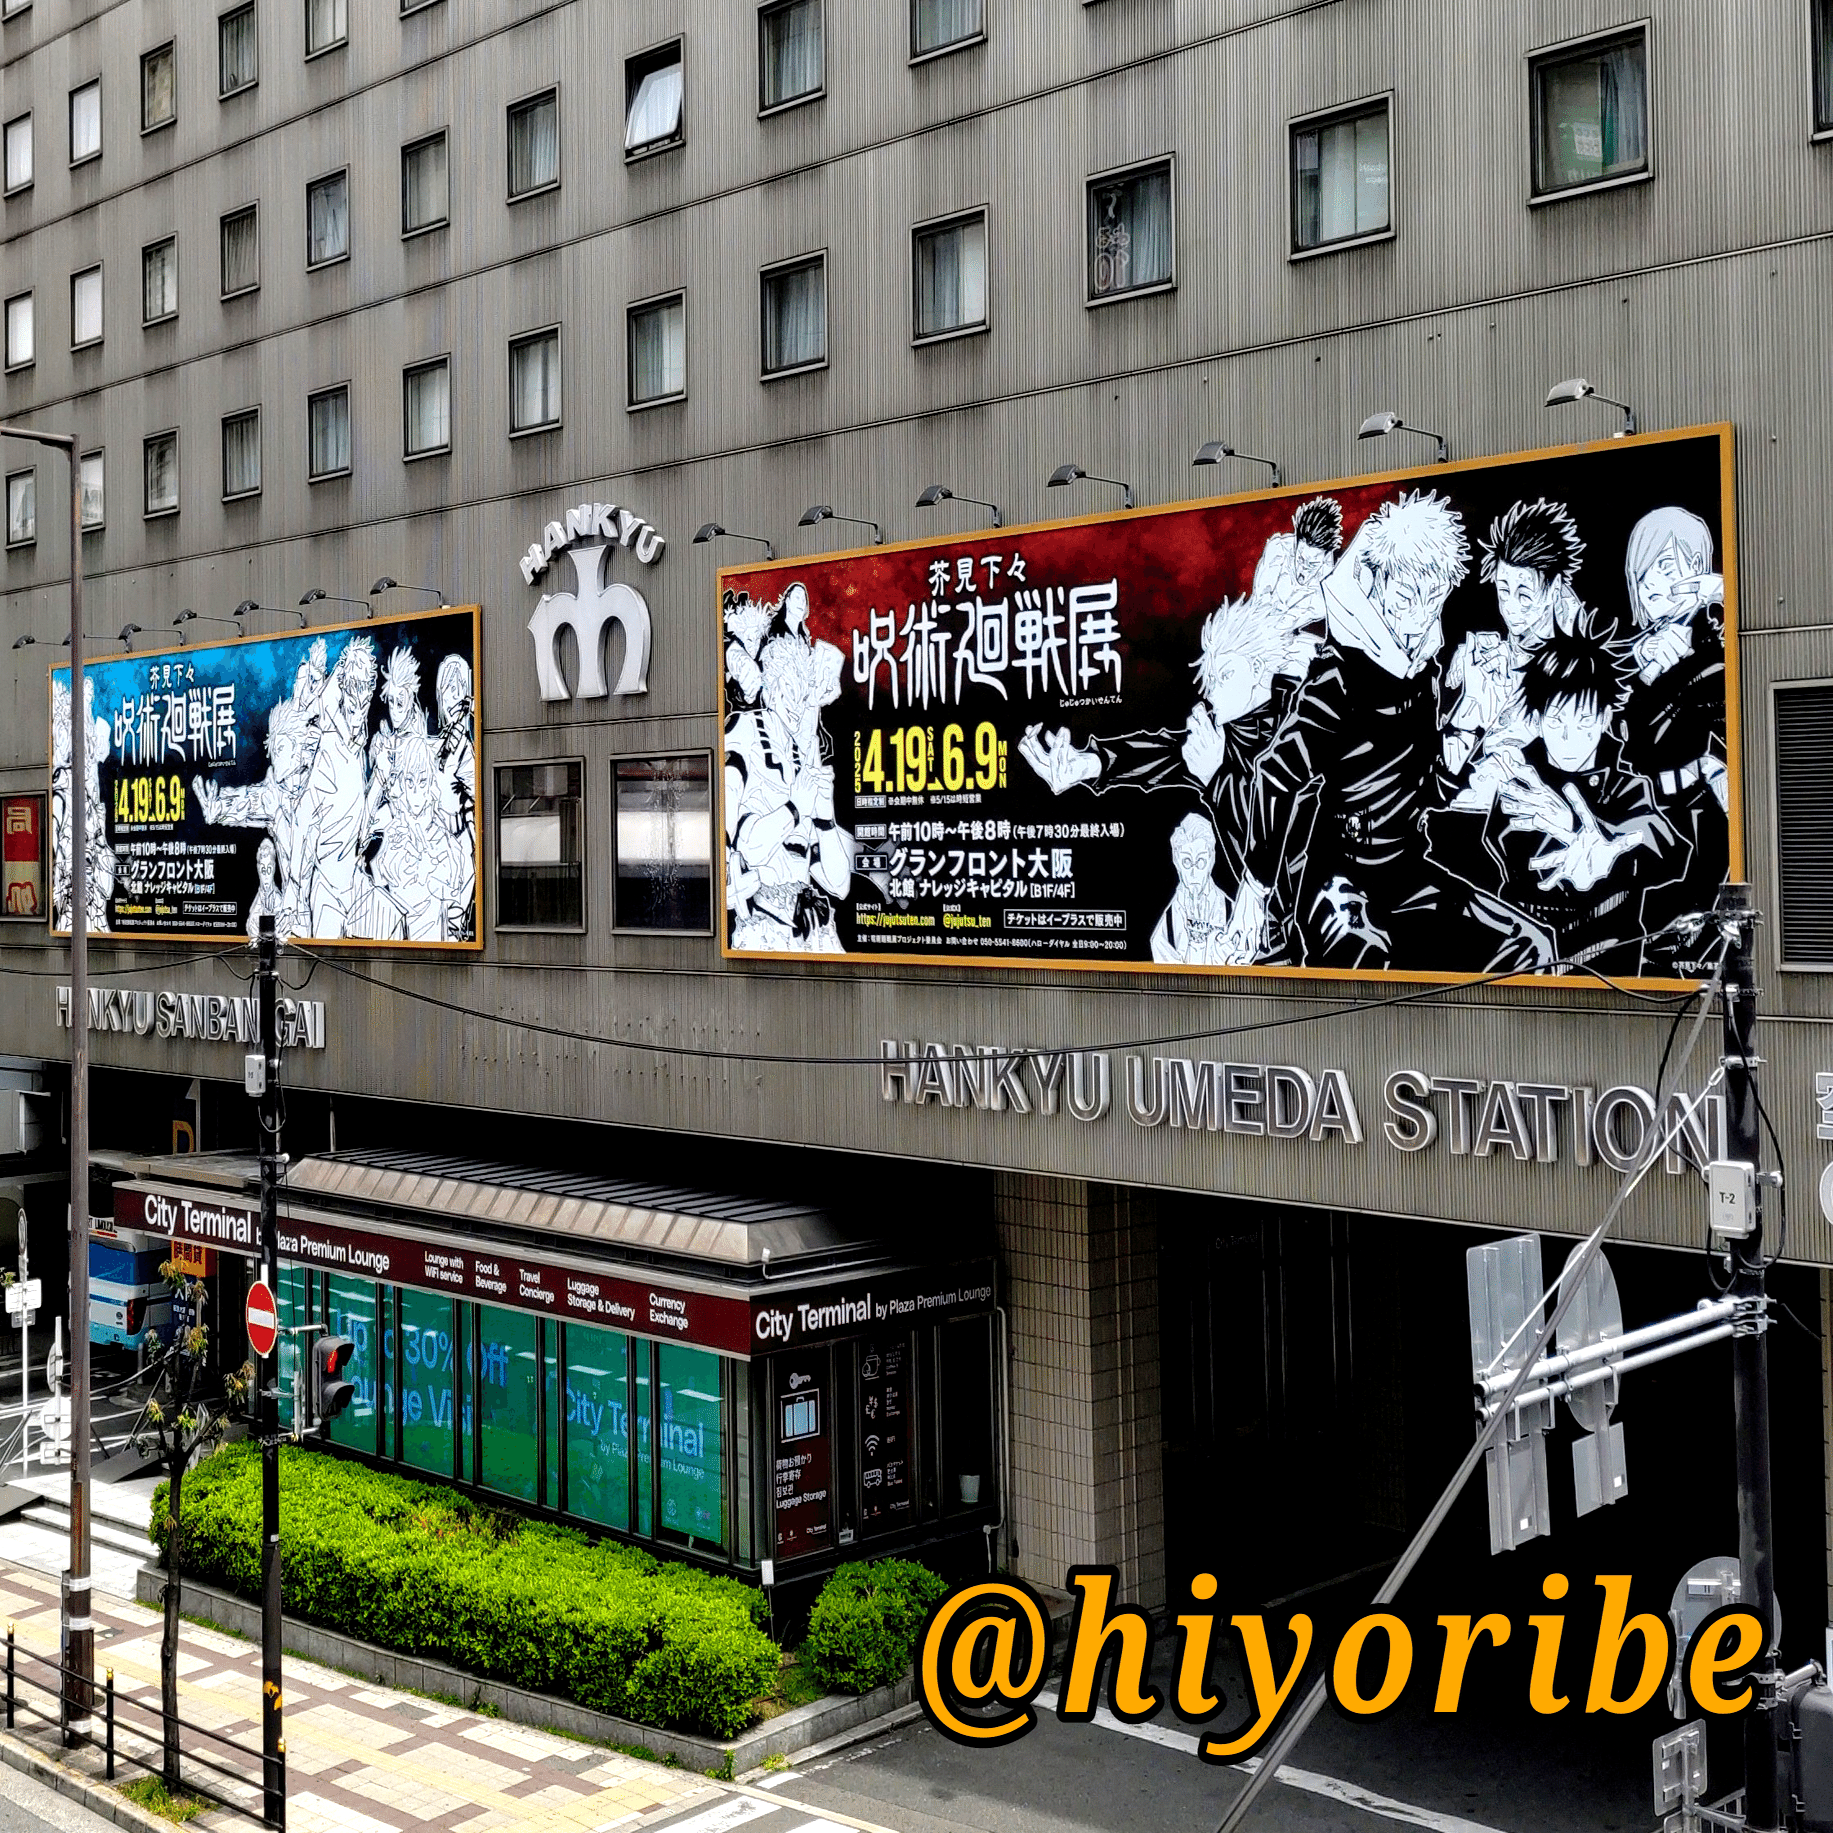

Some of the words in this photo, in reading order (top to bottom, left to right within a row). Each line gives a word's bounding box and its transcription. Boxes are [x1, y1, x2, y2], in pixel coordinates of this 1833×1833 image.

[519, 502, 665, 585] HANKYU
[928, 552, 1027, 596] 芥見下々
[853, 577, 1122, 710] 呪術廻戦展
[149, 663, 195, 690] 芥見下々
[114, 683, 236, 767] 呪術廻戦展
[862, 725, 927, 793] 4.19
[926, 726, 934, 772] SAT
[942, 721, 997, 791] 6.9
[998, 740, 1007, 789] MON
[118, 776, 148, 823] 4.19
[155, 775, 180, 822] 6.9
[131, 859, 215, 880] グランフロント大阪
[889, 847, 1073, 878] グランフロント大阪
[889, 878, 916, 898] 北館
[919, 878, 1028, 898] ナレッジキャピタル
[1007, 913, 1122, 927] チケットはイープラスで販売中
[56, 986, 154, 1036] HNKYU
[880, 1039, 1111, 1122] HANKYU
[1126, 1054, 1364, 1144] UMEDA
[1384, 1069, 1728, 1175] STATION
[1719, 1191, 1736, 1205] T-2
[144, 1194, 178, 1236] City
[181, 1201, 252, 1244] Terminal
[277, 1230, 298, 1252] laza
[300, 1235, 347, 1262] Premium
[348, 1244, 390, 1274] Lounge
[424, 1251, 448, 1268] Lounge
[449, 1256, 464, 1270] with
[475, 1260, 493, 1275] Food
[493, 1263, 500, 1276] &
[440, 1270, 463, 1284] service
[475, 1275, 507, 1294] Beverage
[519, 1268, 541, 1284] Travel
[567, 1277, 600, 1297] Luggage
[519, 1284, 555, 1304] Concierge
[649, 1292, 686, 1314] Currency
[567, 1293, 597, 1312] Storage
[597, 1299, 605, 1312] &
[605, 1300, 636, 1322] Delivery
[755, 1308, 793, 1342] City
[797, 1293, 871, 1332] Terminal
[875, 1302, 887, 1320] by
[889, 1299, 915, 1316] Plaza
[917, 1291, 957, 1311] Premium
[958, 1286, 992, 1302] Lounge
[649, 1308, 689, 1331] Exchange
[775, 1496, 802, 1509] Luggage
[803, 1490, 827, 1503] Storage
